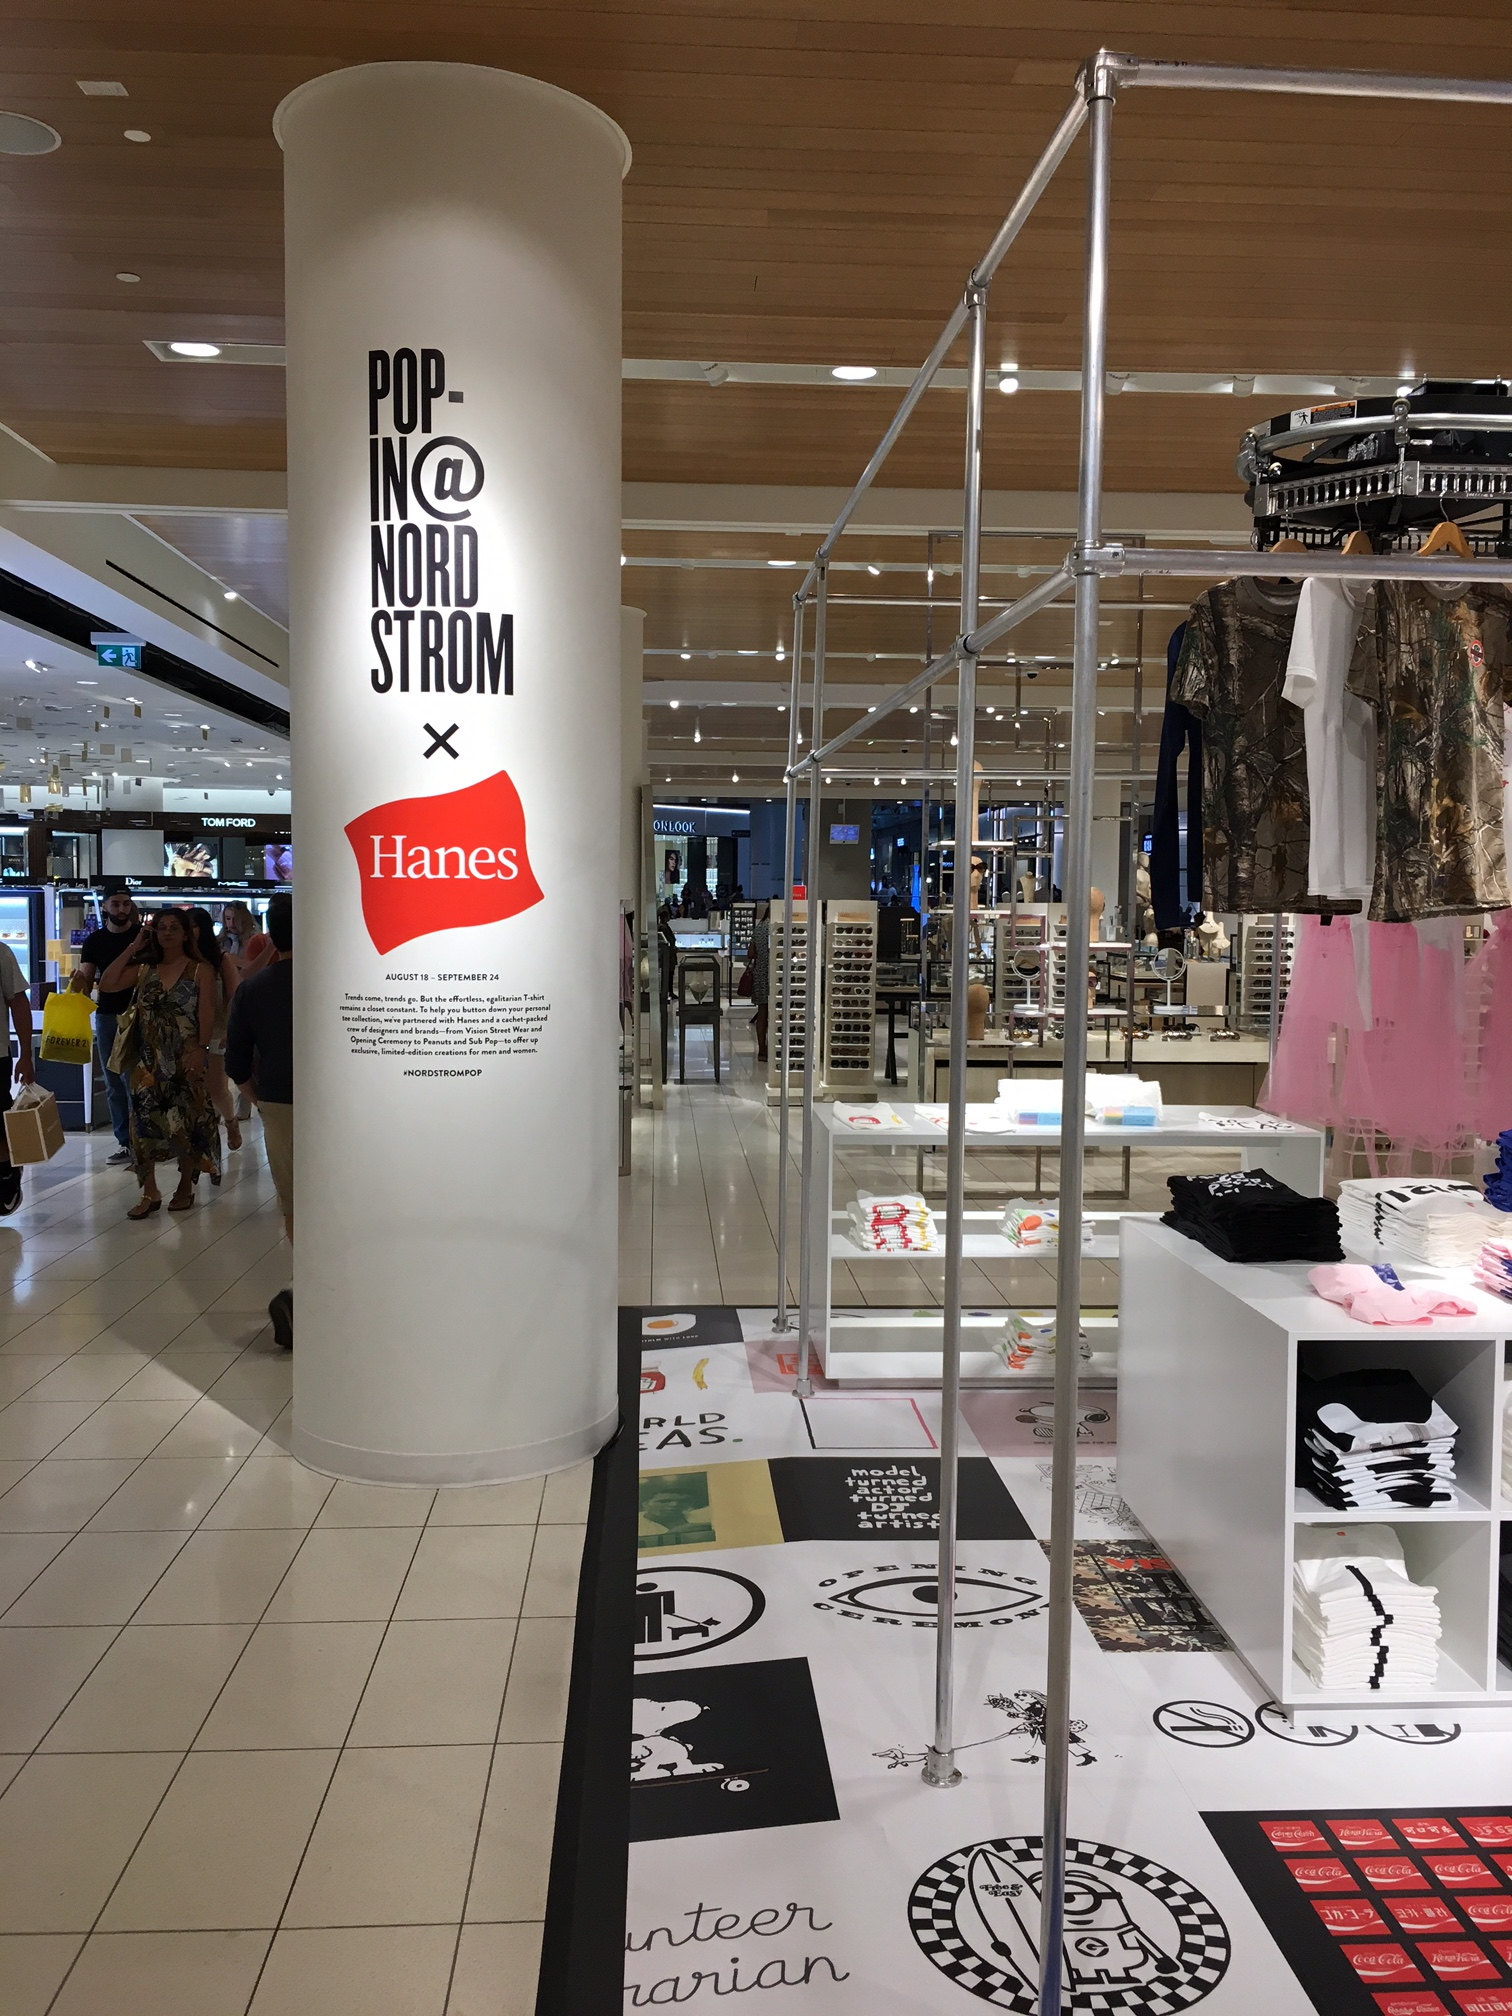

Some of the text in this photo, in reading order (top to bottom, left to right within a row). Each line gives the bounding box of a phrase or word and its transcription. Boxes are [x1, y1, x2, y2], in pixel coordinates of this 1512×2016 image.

[369, 347, 464, 435] POP-
[371, 523, 478, 607] NORD
[371, 610, 514, 696] STROM
[201, 817, 256, 827] TOM FORD
[370, 835, 518, 880] Hanes
[125, 877, 142, 886] Dior
[437, 973, 488, 981] SEPTEMBER
[489, 973, 500, 981] 24
[344, 992, 363, 1001] Trends
[407, 997, 419, 1005] go.
[434, 995, 447, 1003] the
[448, 995, 485, 1003] effortless,
[486, 994, 522, 1005] egalitarian
[523, 993, 545, 1001] T-shirt
[339, 1004, 361, 1012] remains
[429, 1006, 446, 1015] help
[447, 1007, 461, 1015] you
[462, 1005, 487, 1013] button
[488, 1005, 507, 1013] down
[508, 1006, 524, 1015] your
[525, 1003, 551, 1014] personal
[351, 1015, 382, 1024] collection,
[402, 1017, 437, 1025] partnered
[501, 1015, 548, 1024] cachet-packed
[368, 1026, 399, 1036] designers
[465, 1026, 488, 1034] Vision
[489, 1026, 511, 1034] Street
[512, 1025, 529, 1033] Wear
[46, 1036, 80, 1047] FOREVER
[350, 1035, 377, 1046] Opening
[377, 1037, 412, 1047] Ceremony
[423, 1037, 452, 1045] Peanuts
[468, 1037, 483, 1045] Sub
[513, 1036, 529, 1044] offer
[350, 1047, 380, 1056] exclusive,
[381, 1047, 432, 1056] limited-edition
[434, 1048, 467, 1056] creations
[498, 1047, 512, 1055] and
[403, 1069, 482, 1077] #NORDSTROMPOP
[851, 1465, 921, 1477] model
[845, 1475, 927, 1487] turned
[856, 1485, 924, 1495] actor
[849, 1492, 933, 1503] turned
[871, 1502, 910, 1512] DJ
[858, 1519, 940, 1529] artist
